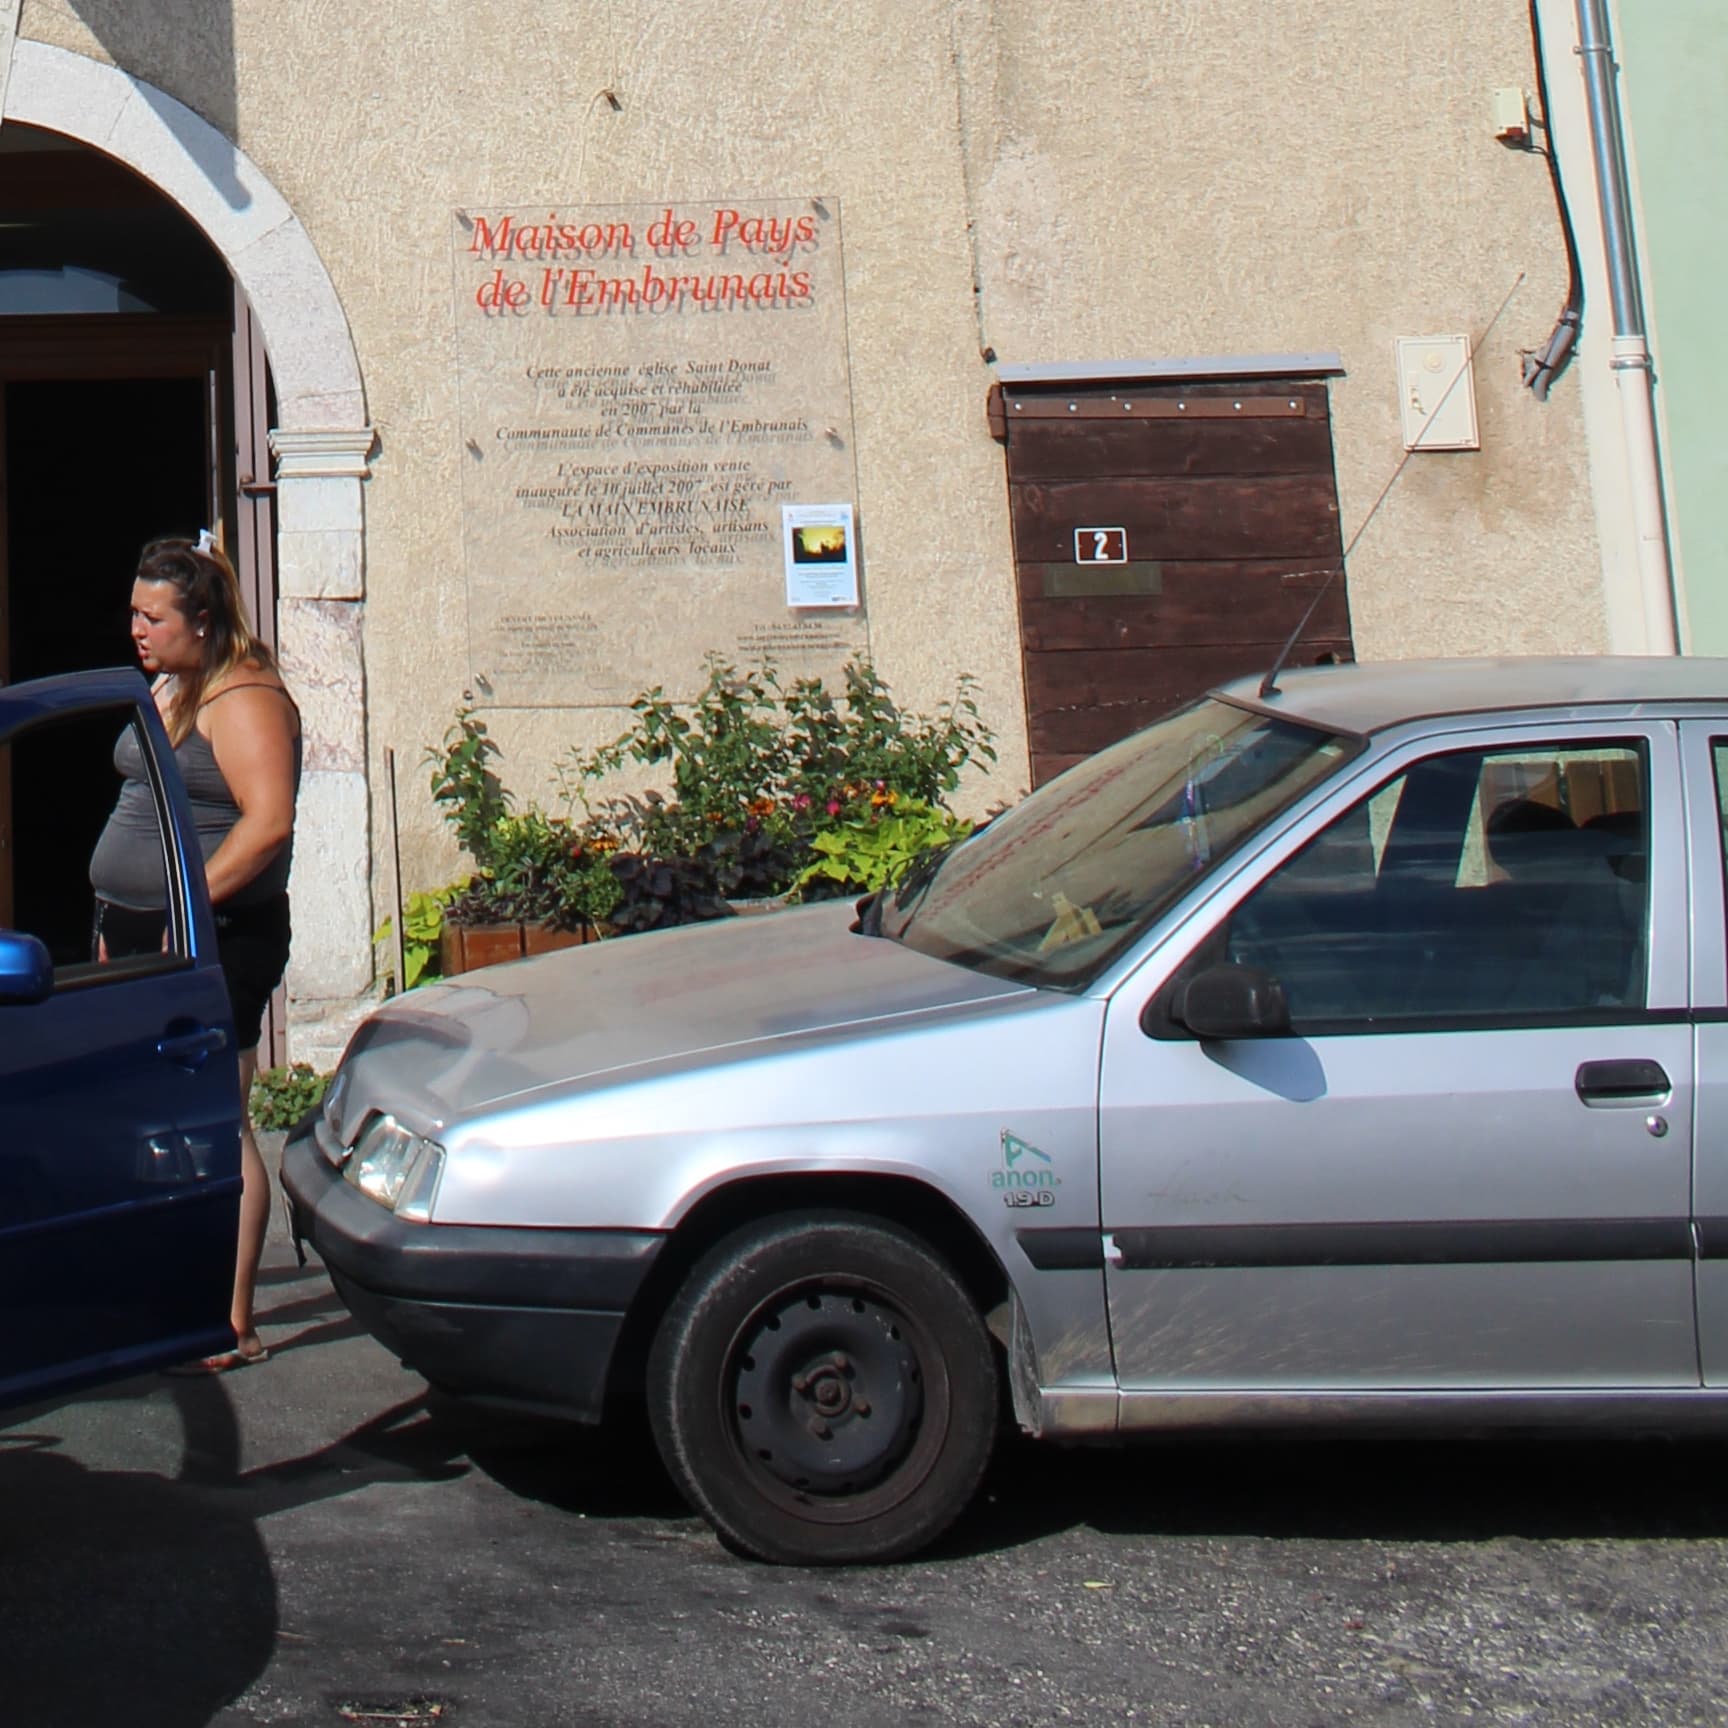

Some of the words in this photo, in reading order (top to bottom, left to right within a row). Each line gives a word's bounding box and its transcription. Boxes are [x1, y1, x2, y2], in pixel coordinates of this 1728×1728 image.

[468, 212, 632, 252] Maison
[646, 209, 696, 247] de
[711, 209, 815, 253] Pays
[475, 269, 526, 308] de
[540, 260, 811, 306] l'Embrunais
[526, 365, 561, 379] Cette
[566, 364, 630, 378] ancienne
[638, 361, 678, 377] église
[685, 360, 723, 374] Saint
[728, 358, 771, 372] Donat
[570, 386, 591, 399] été
[594, 382, 648, 400] acquise
[651, 383, 664, 395] et
[601, 407, 618, 417] en
[622, 401, 657, 416] 2007
[659, 404, 683, 418] par
[688, 400, 701, 414] la
[496, 424, 592, 440] Communauté
[595, 423, 611, 437] de
[616, 422, 694, 437] Communes
[699, 419, 715, 434] de
[719, 417, 809, 433] l'Embrunais
[556, 463, 620, 479] L'espace
[622, 460, 709, 478] d'exposition
[713, 460, 752, 472] vente
[515, 483, 581, 499] inauguré
[585, 482, 598, 497] le
[620, 480, 664, 498] juillet
[668, 479, 703, 494] 2007
[733, 480, 765, 495] géré
[767, 479, 793, 495] par
[638, 497, 749, 515] EMBRUNAISE
[547, 525, 626, 538] Association
[712, 519, 769, 533] artisans
[577, 545, 591, 558] et
[594, 542, 681, 559] agriculteurs
[689, 541, 737, 555] locaux
[1093, 531, 1110, 561] 2
